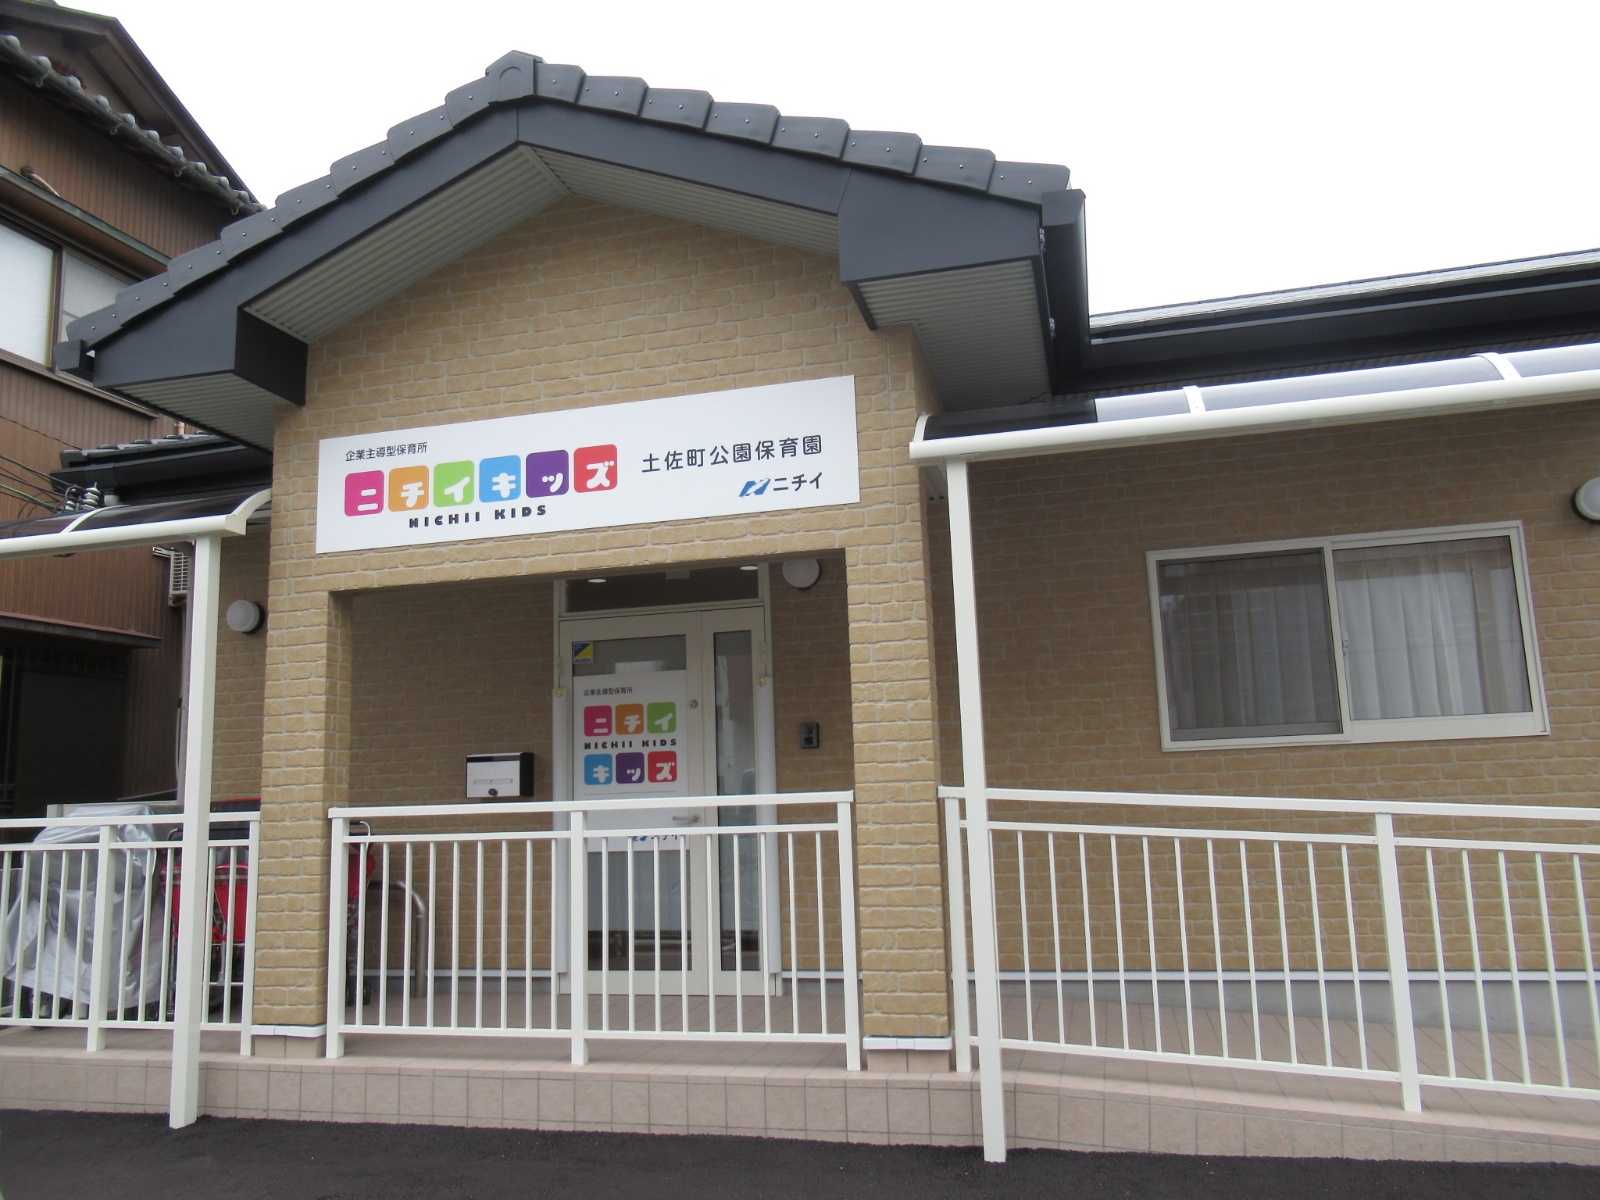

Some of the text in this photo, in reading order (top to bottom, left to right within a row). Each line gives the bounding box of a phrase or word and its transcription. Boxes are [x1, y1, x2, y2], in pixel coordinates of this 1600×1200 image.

[345, 441, 428, 461] 企業主導型保育所
[642, 435, 822, 473] 土佐町公園保育園
[357, 459, 616, 512] ニチイキッズ
[773, 472, 823, 491] ニチイ
[409, 505, 546, 528] NICHII KIDS
[591, 711, 674, 734] ニチイ
[584, 738, 677, 750] NICHII KIDS
[591, 760, 676, 784] キッズ
